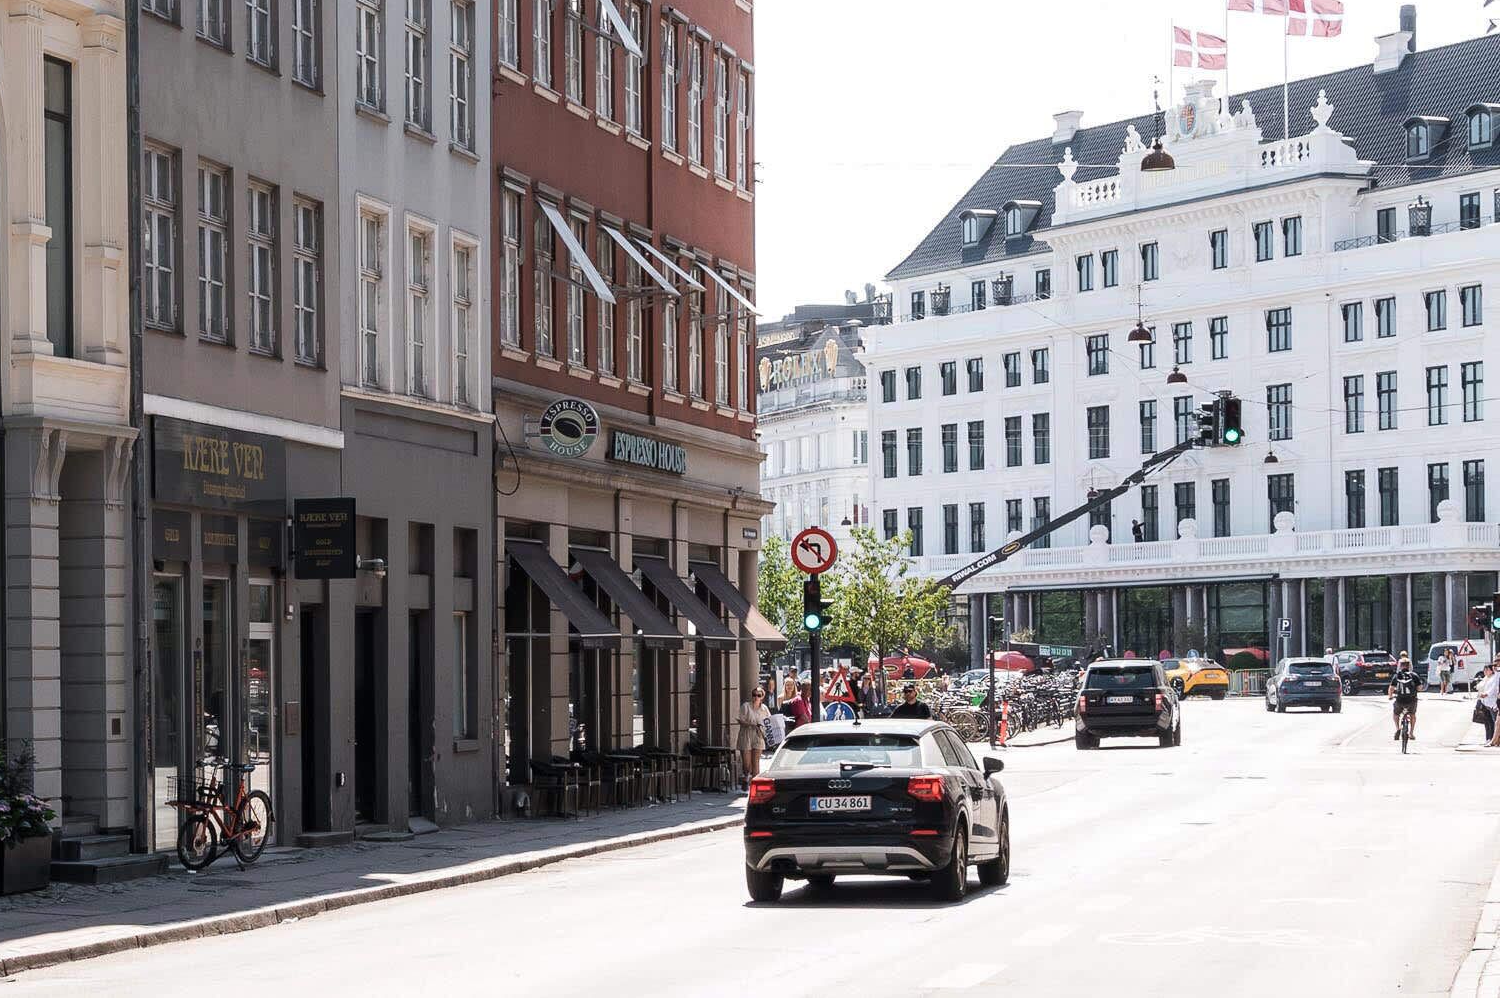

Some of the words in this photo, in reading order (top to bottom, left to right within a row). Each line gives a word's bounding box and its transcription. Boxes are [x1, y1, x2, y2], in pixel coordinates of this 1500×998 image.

[546, 401, 594, 423] ESPRESSO
[549, 440, 588, 456] HOUSE
[614, 431, 657, 468] ESPRESSO
[658, 441, 687, 474] HOUSE
[232, 442, 264, 480] VEN
[817, 799, 832, 809] CU
[834, 798, 847, 808] 34
[850, 797, 869, 808] 861
